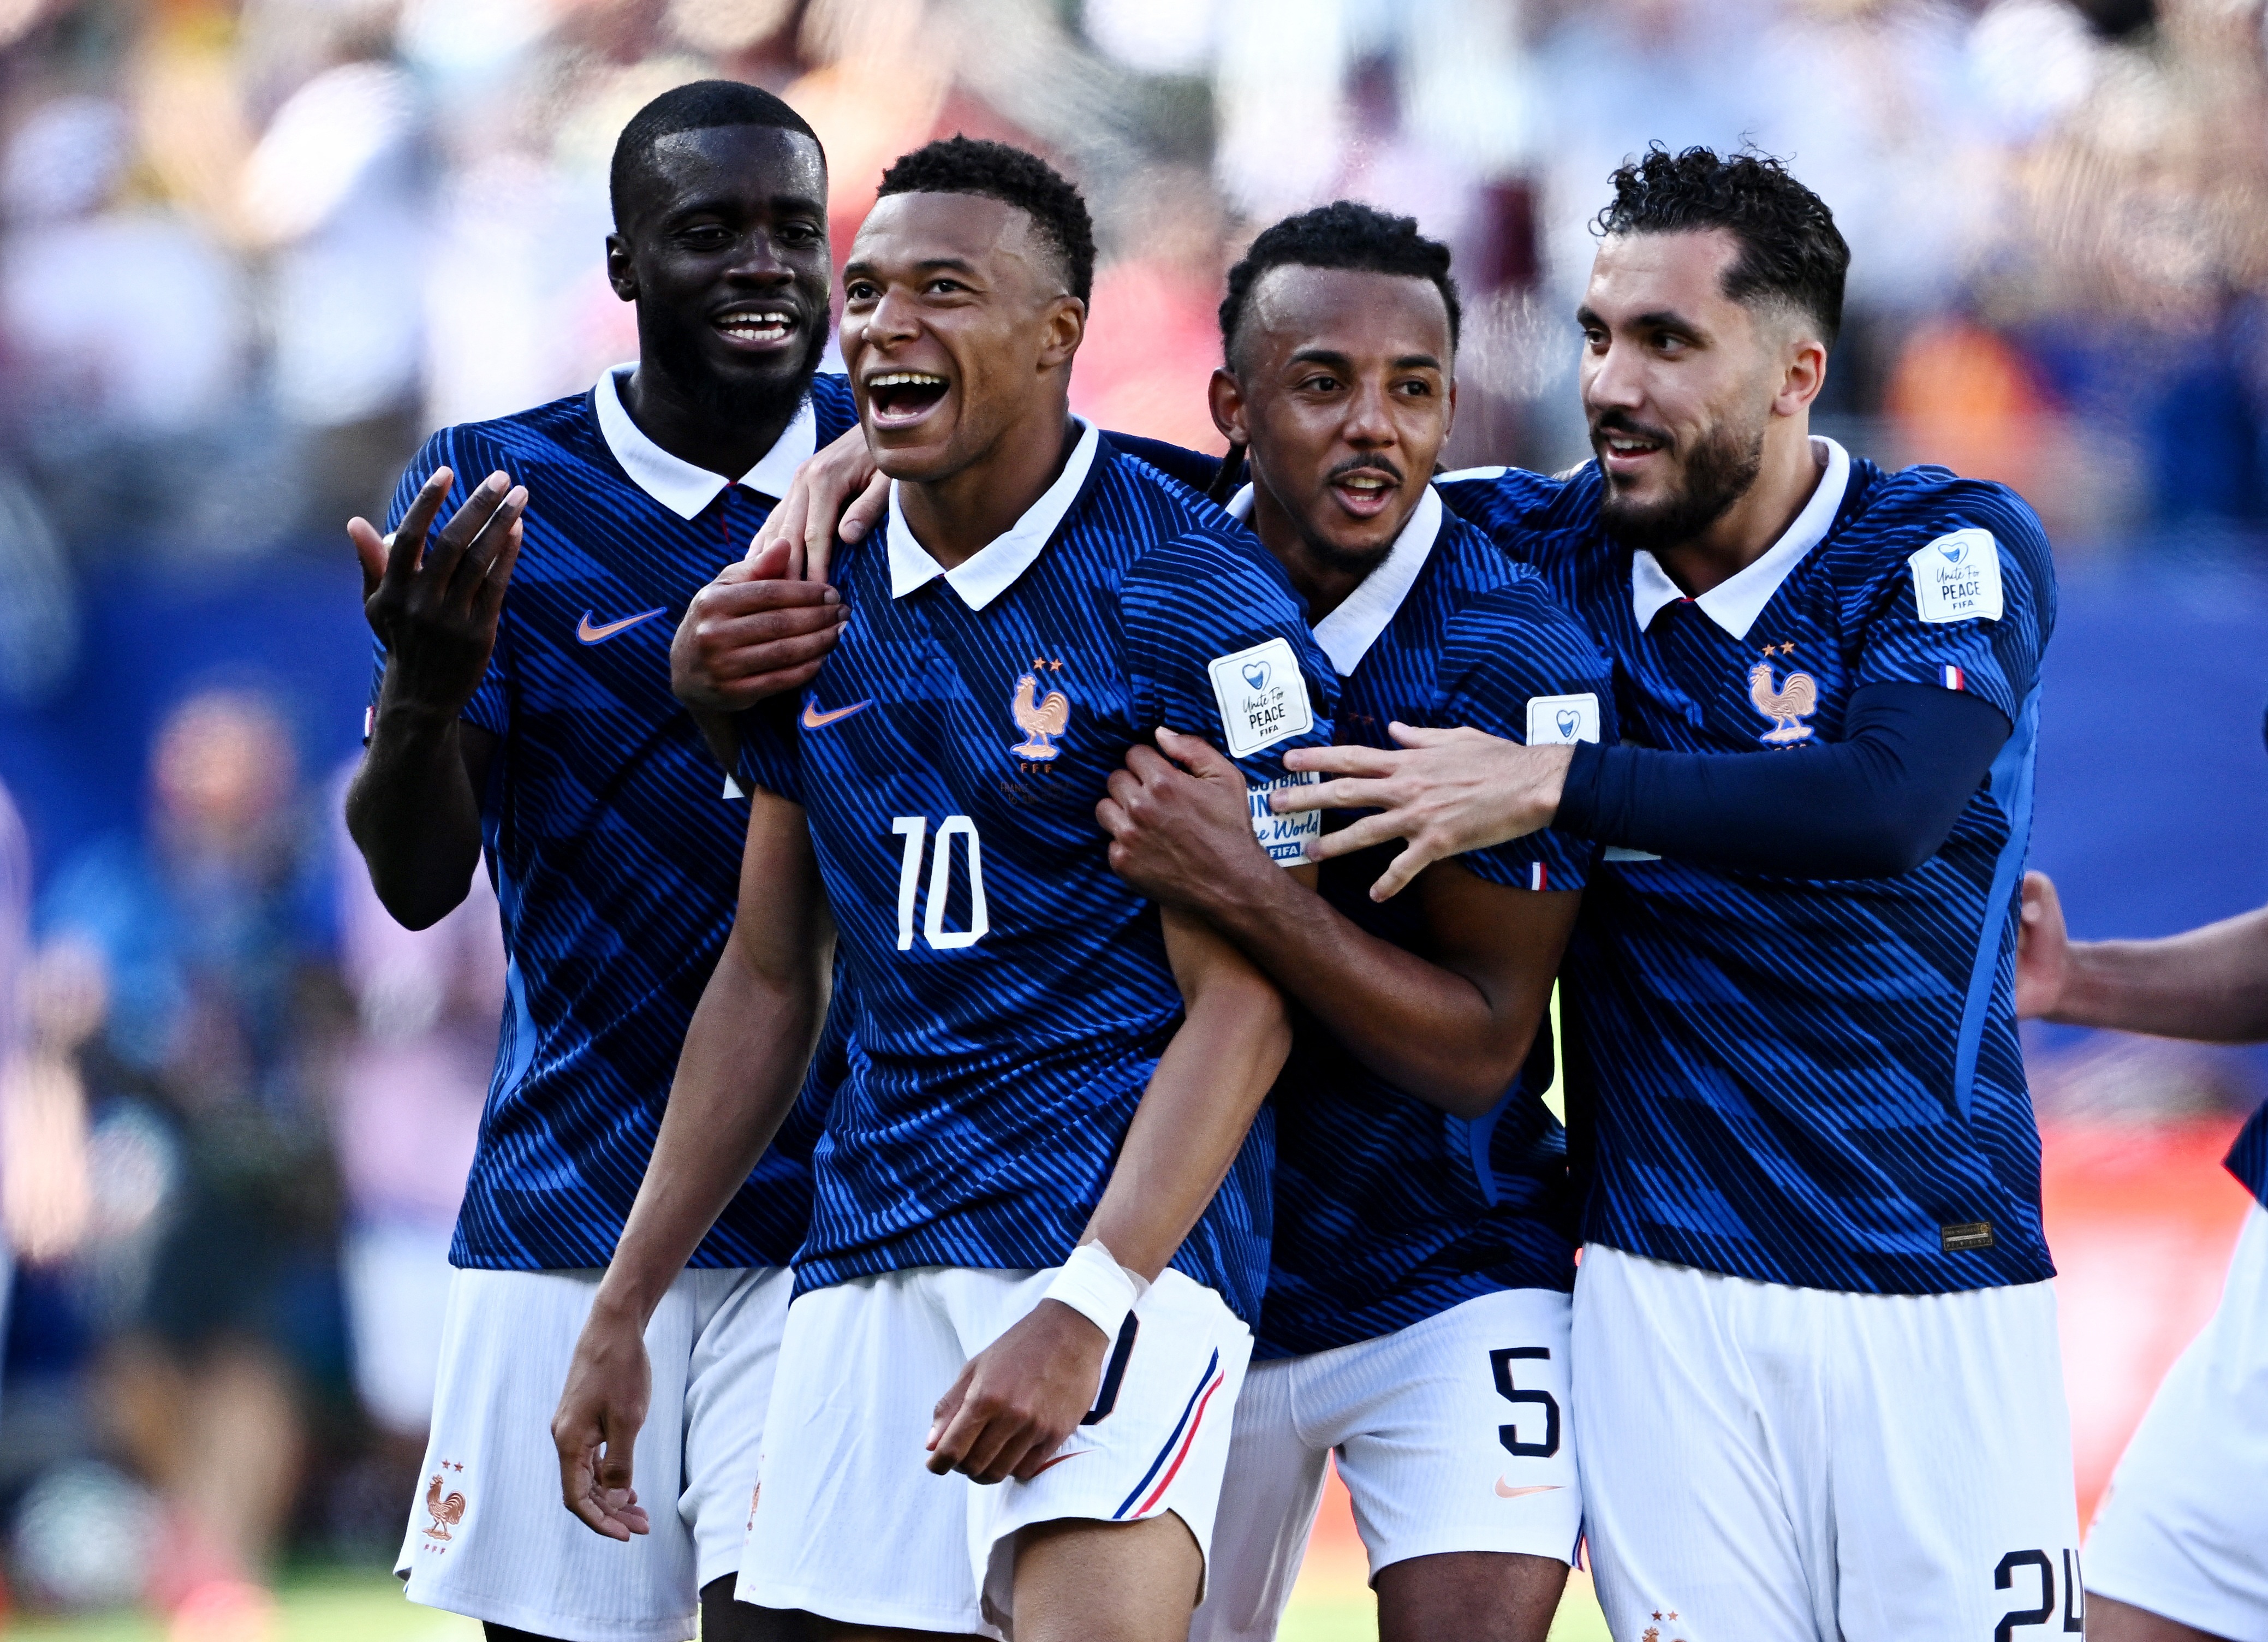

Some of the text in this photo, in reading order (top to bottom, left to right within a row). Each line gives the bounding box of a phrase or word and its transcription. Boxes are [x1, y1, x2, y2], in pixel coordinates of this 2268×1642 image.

[1936, 564, 1979, 584] Unite For
[1942, 581, 1981, 600] PEACE
[1952, 599, 1974, 610] FIFA
[1242, 686, 1284, 713] Unite For
[1249, 703, 1285, 729] PEACE
[1260, 724, 1278, 737] FIFA
[1273, 812, 1319, 840] World
[1269, 846, 1298, 858] FIFA
[892, 815, 990, 950] 10
[1489, 1347, 1561, 1458] 5
